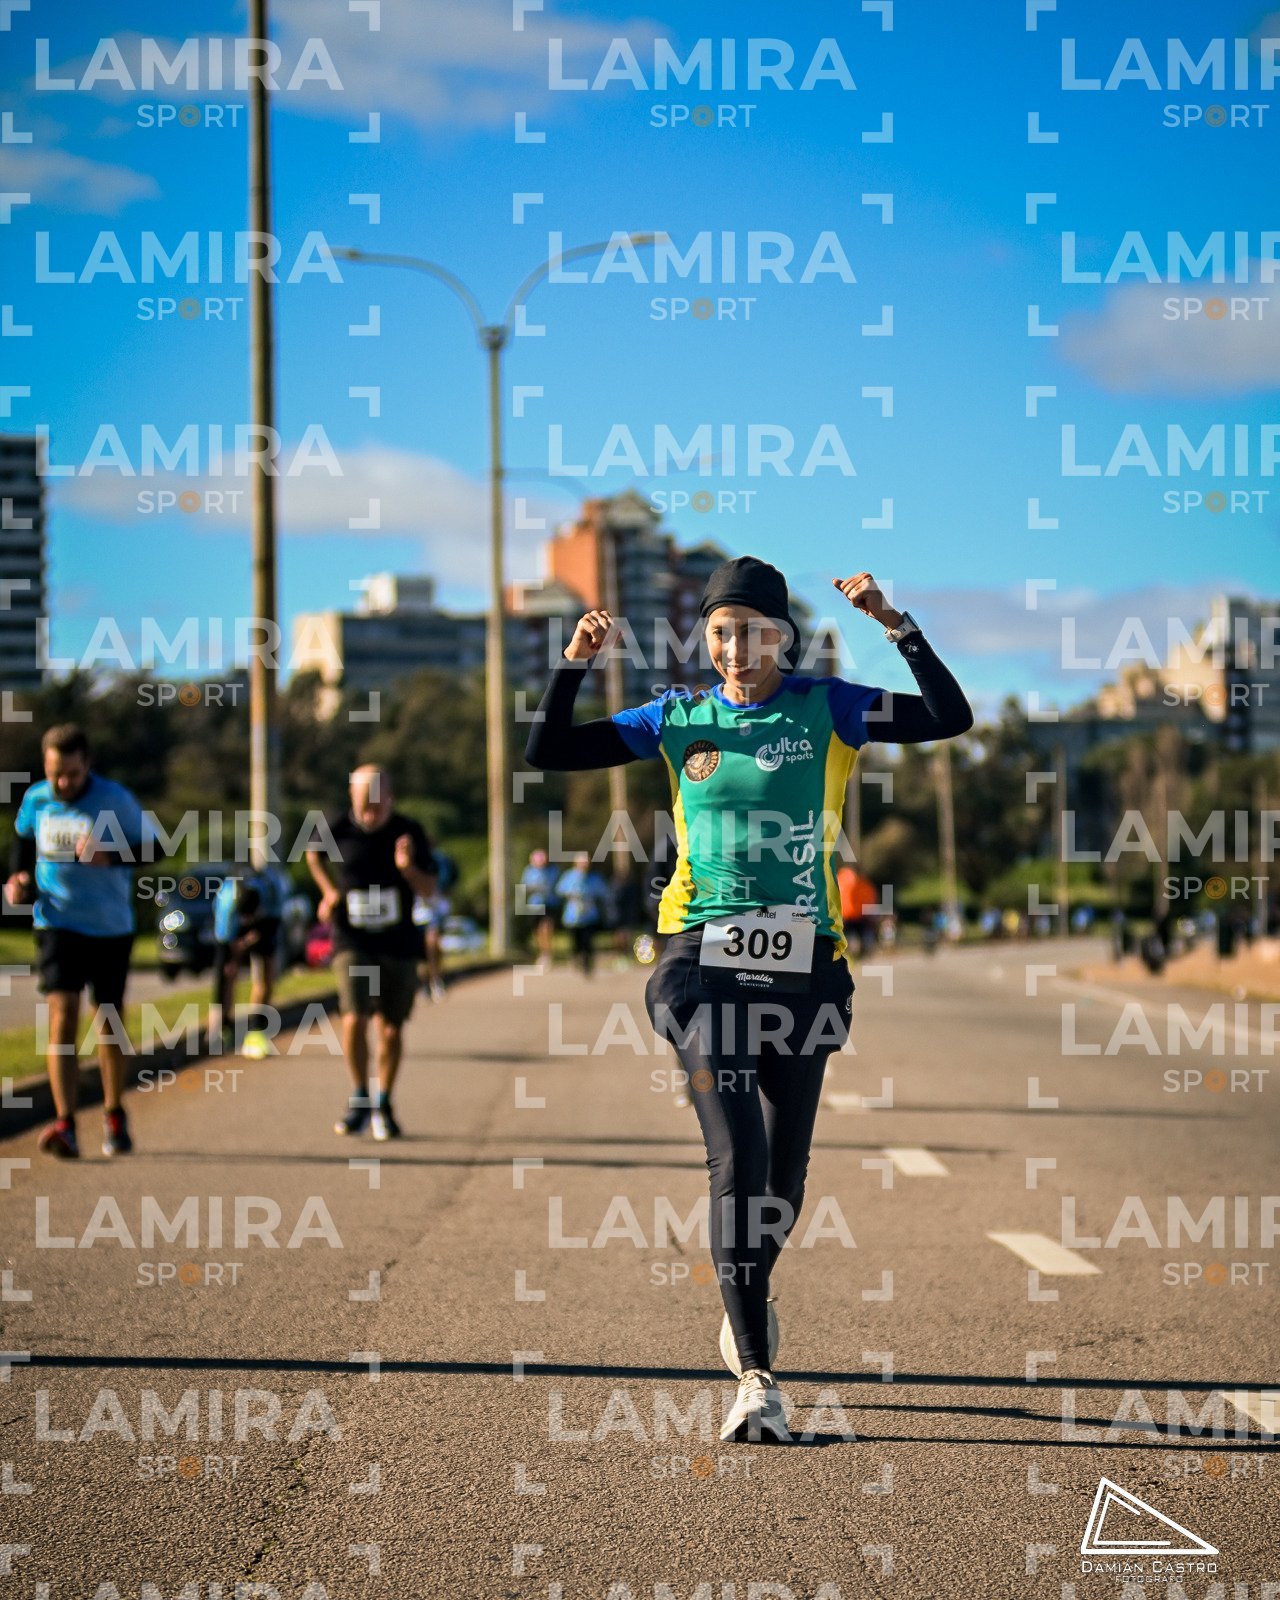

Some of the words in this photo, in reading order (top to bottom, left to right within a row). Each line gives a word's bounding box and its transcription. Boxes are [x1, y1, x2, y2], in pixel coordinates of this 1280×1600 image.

[786, 752, 814, 763] sports
[723, 926, 793, 961] 309
[735, 972, 774, 984] Maratón
